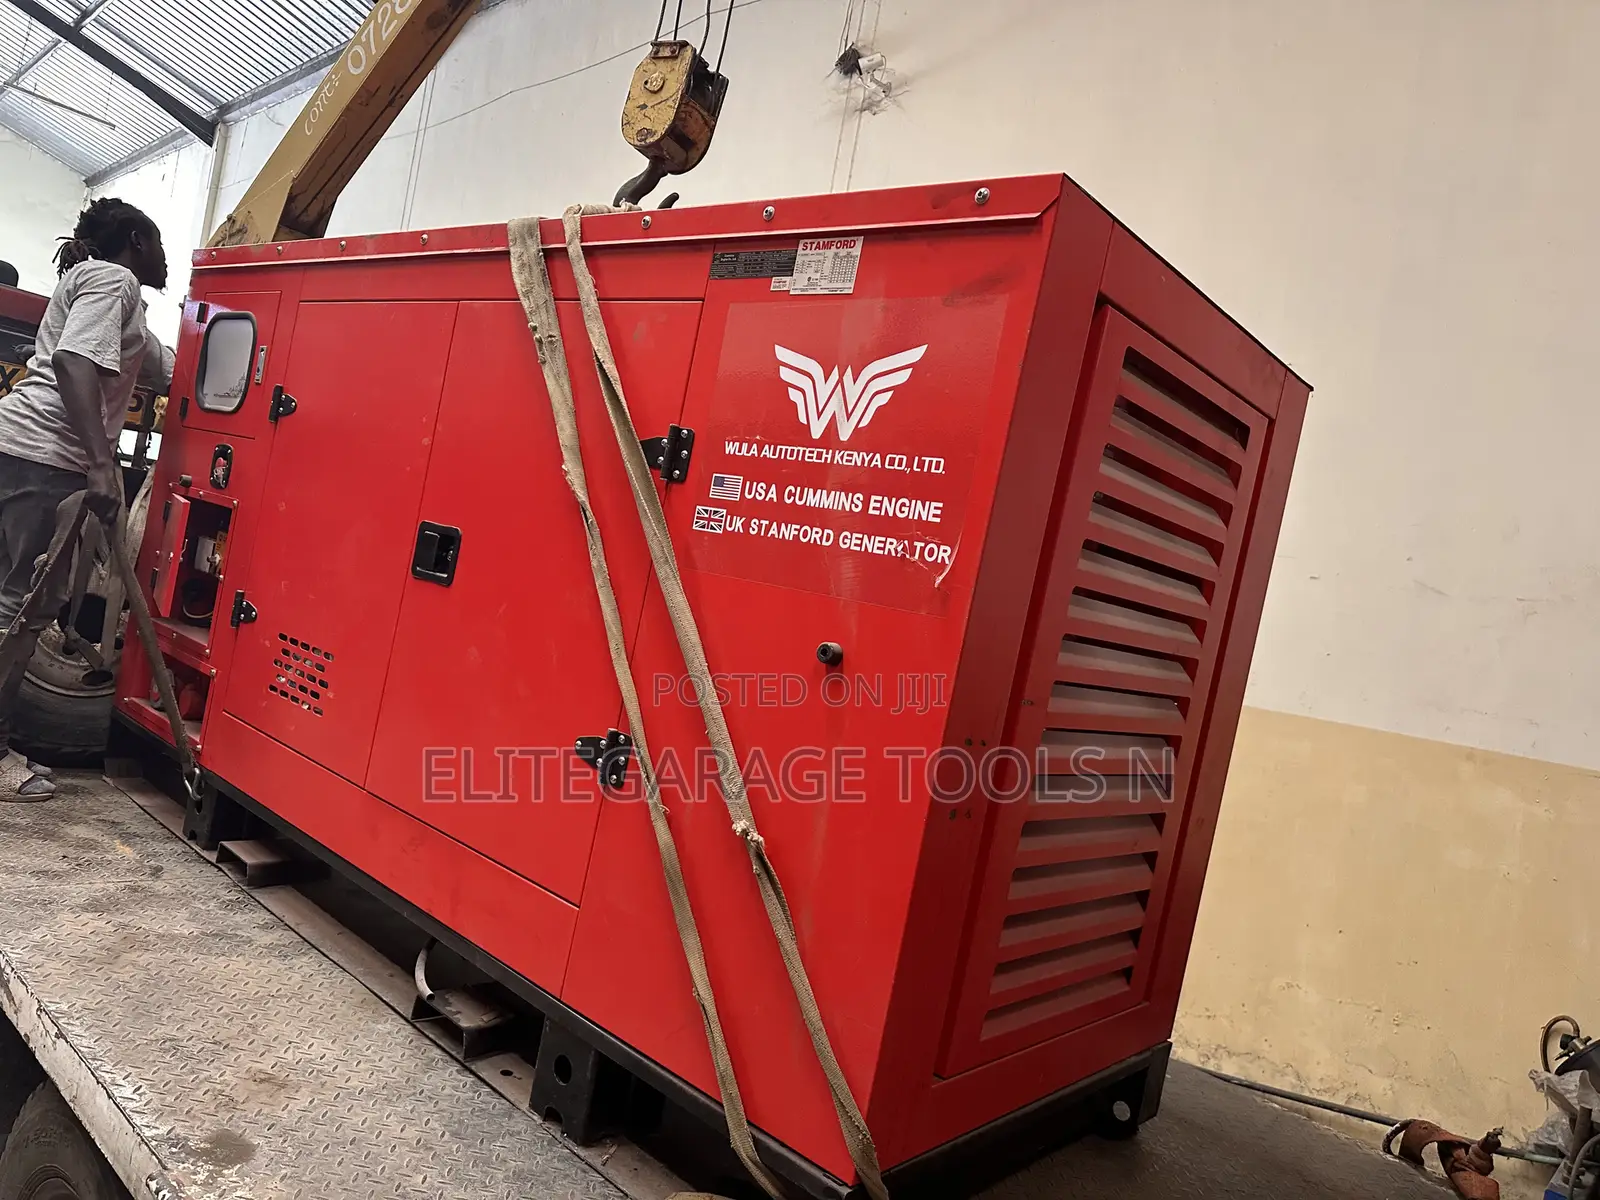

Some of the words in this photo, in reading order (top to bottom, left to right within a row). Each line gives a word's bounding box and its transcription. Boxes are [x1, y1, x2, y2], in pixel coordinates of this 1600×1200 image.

[801, 239, 857, 251] STAMFORD
[724, 440, 758, 458] WULA
[760, 444, 831, 464] AUTOTECH
[834, 448, 882, 469] KENYA
[913, 455, 946, 475] LTD.
[744, 480, 778, 503] USA
[783, 485, 864, 513] CUMMINS
[867, 495, 944, 523] ENGINE
[725, 514, 747, 534] UK
[749, 517, 834, 547] STANFORD
[839, 530, 951, 565] GENERATOR
